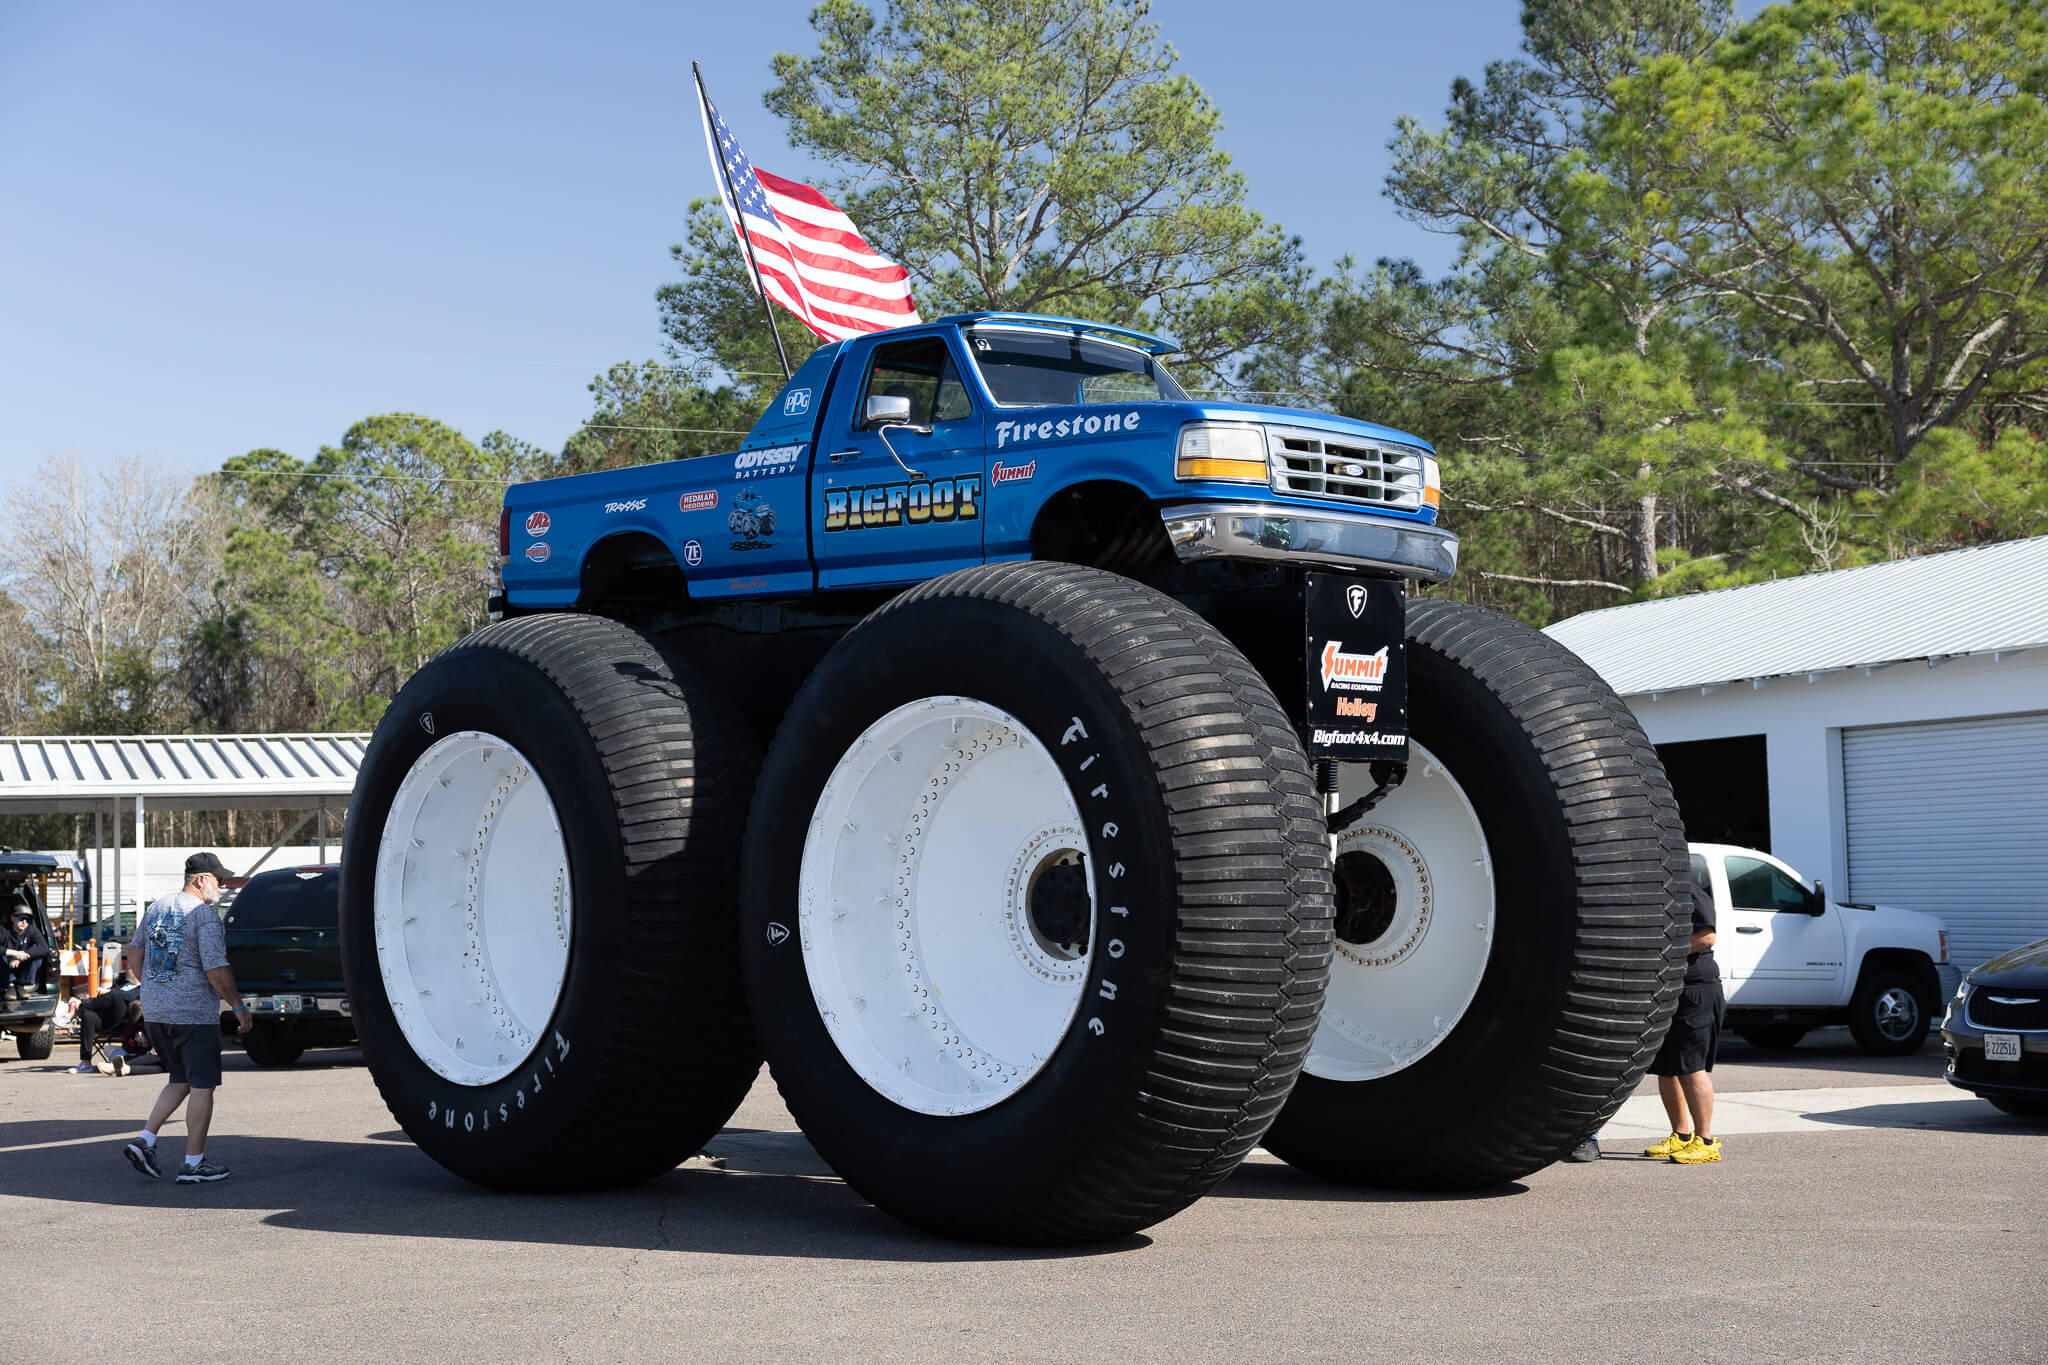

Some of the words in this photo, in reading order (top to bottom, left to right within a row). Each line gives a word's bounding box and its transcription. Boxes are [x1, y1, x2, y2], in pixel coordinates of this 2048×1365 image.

[976, 339, 989, 350] 9
[785, 391, 810, 413] PPG
[994, 411, 1141, 449] Firestone
[734, 444, 808, 470] ODYSSEY
[735, 464, 796, 480] BATTERY
[683, 492, 715, 504] HEDMAN
[825, 472, 982, 532] BIGFOOT
[686, 544, 700, 561] ZF
[1330, 682, 1351, 691] RACING
[1351, 683, 1383, 693] EQUIPMENT
[1336, 697, 1378, 723] Holley
[1312, 729, 1406, 748] Bigfoot4x4.com
[1061, 716, 1129, 1036] Firestone
[1991, 1041, 2017, 1056] 222516
[428, 1029, 571, 1133] Firestone
